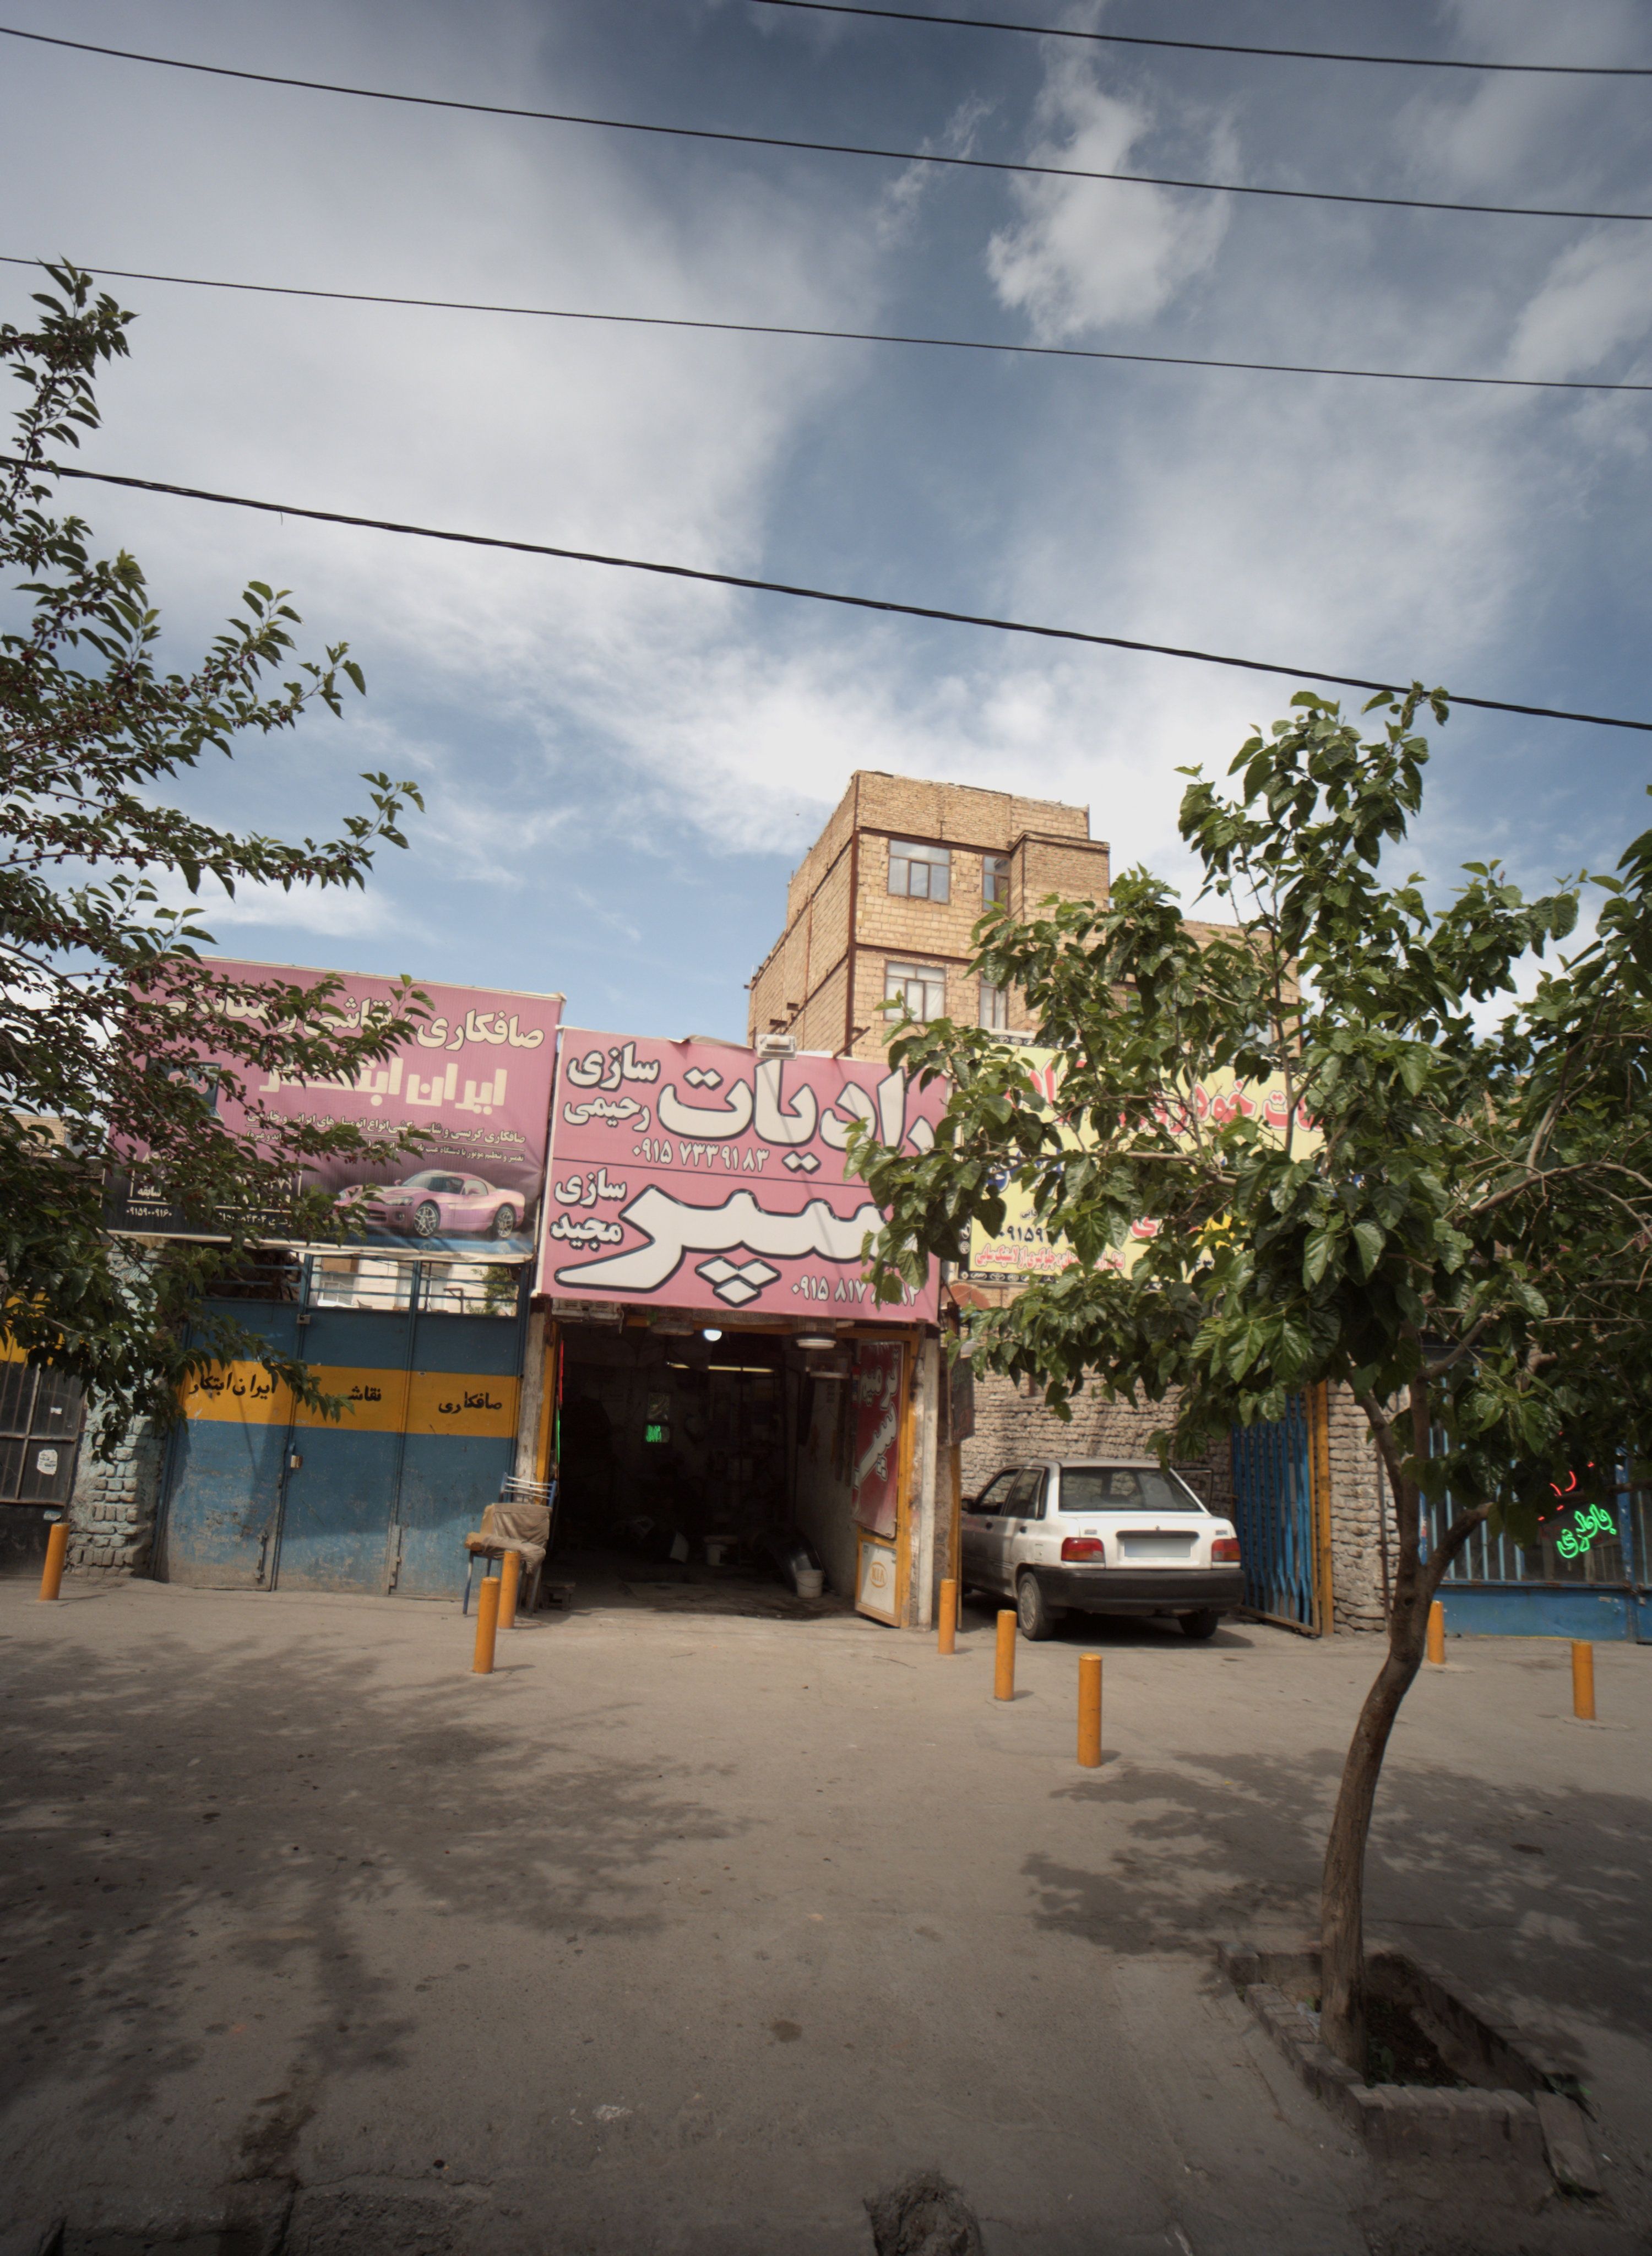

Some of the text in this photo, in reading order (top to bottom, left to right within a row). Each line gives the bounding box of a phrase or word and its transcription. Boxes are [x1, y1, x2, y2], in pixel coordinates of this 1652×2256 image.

[417, 1008, 545, 1051] صافکاری
[567, 1041, 660, 1091] سازی
[406, 1062, 508, 1115] ایران
[282, 1115, 288, 1125] و
[317, 1114, 335, 1127] های
[415, 1123, 442, 1135] شاس
[563, 1096, 650, 1132] رحیمی
[657, 1059, 936, 1174] رادیات
[442, 1129, 449, 1139] و
[485, 1130, 525, 1144] صافکاری
[632, 1137, 673, 1164] ۰۹۱۵
[551, 1213, 623, 1250] مجید
[554, 1168, 921, 1308] سپر سازی
[791, 1275, 829, 1301] ۰۹۱۵
[188, 1372, 502, 1414] صافکاری نقاش ایران ابتکار
